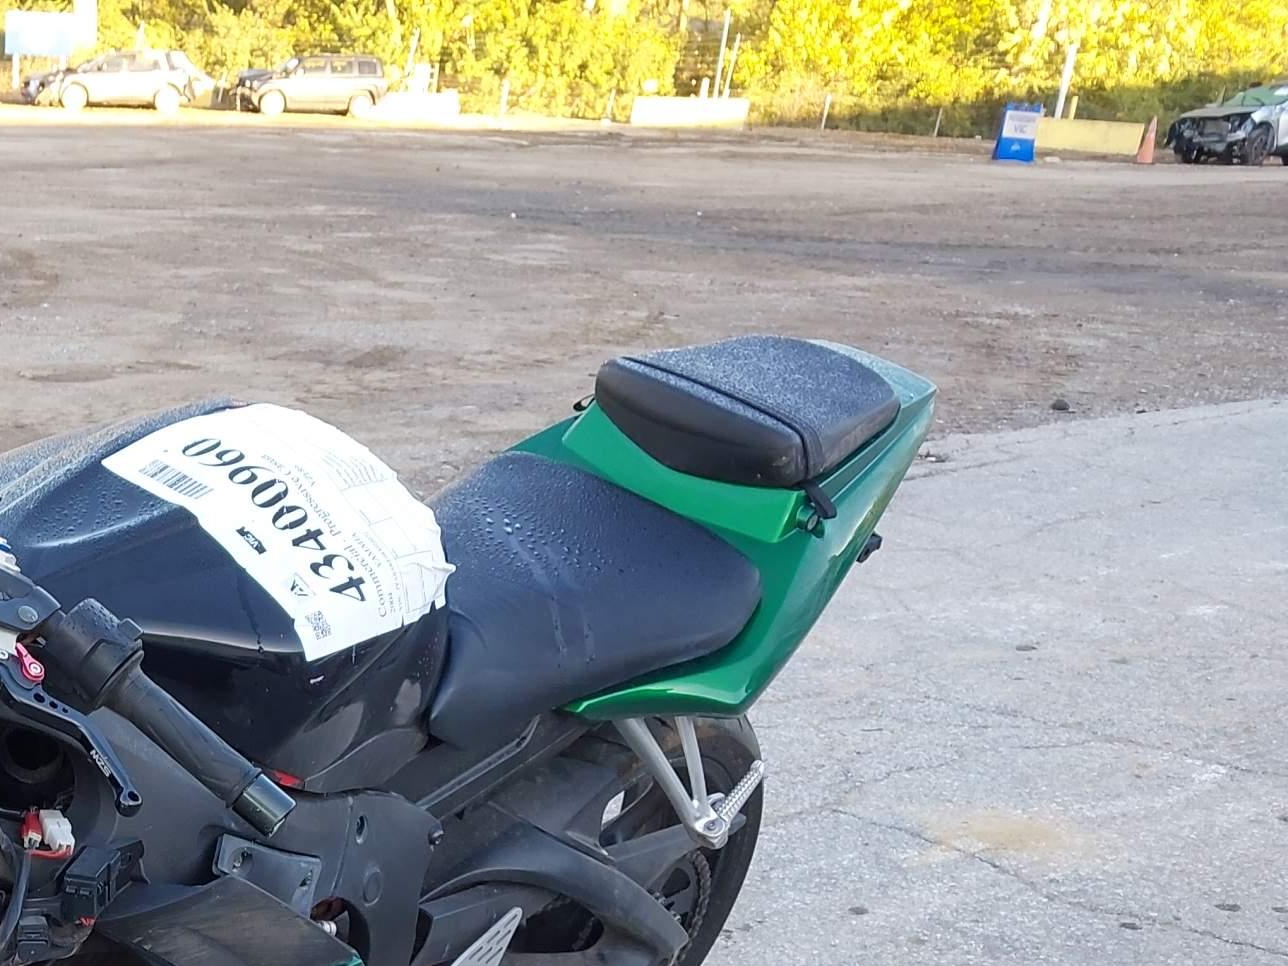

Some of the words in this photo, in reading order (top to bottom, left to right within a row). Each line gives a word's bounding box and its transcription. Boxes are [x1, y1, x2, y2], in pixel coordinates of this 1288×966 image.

[181, 438, 367, 602] 43400960
[291, 474, 343, 537] Progressive
[343, 544, 387, 618] Commercial
